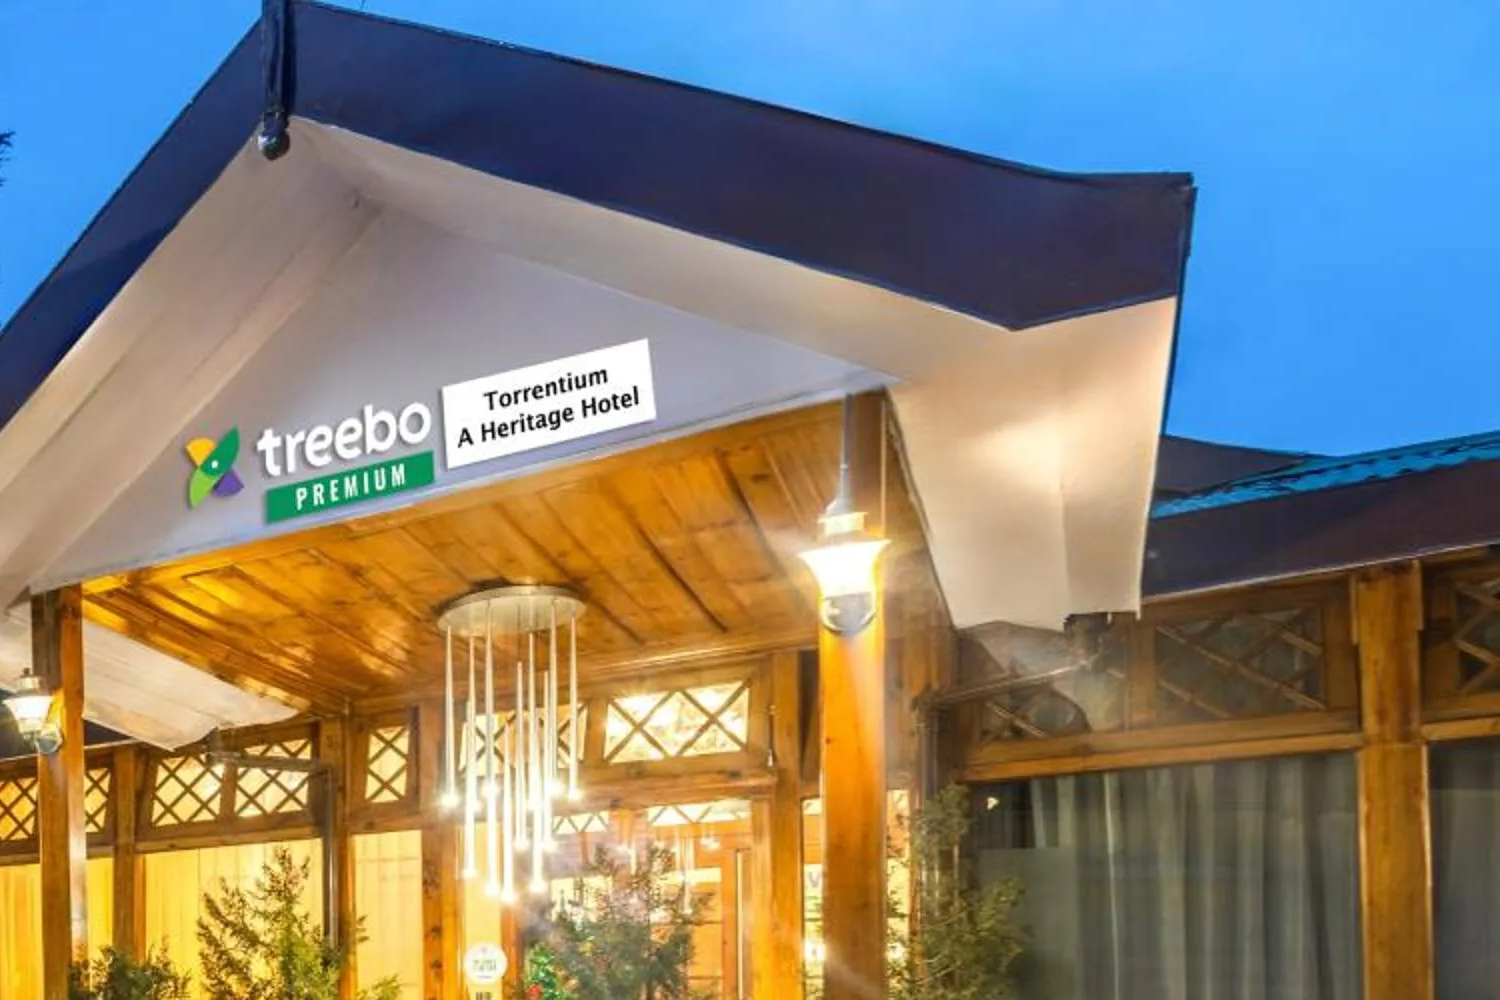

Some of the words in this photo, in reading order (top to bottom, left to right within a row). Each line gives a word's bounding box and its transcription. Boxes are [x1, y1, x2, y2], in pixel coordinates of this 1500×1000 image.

[456, 427, 475, 449] A
[480, 405, 575, 443] Heritage
[580, 384, 640, 419] Hotel
[483, 368, 609, 411] Torrentium
[256, 402, 433, 477] treebo
[295, 462, 406, 511] PREMIUM
